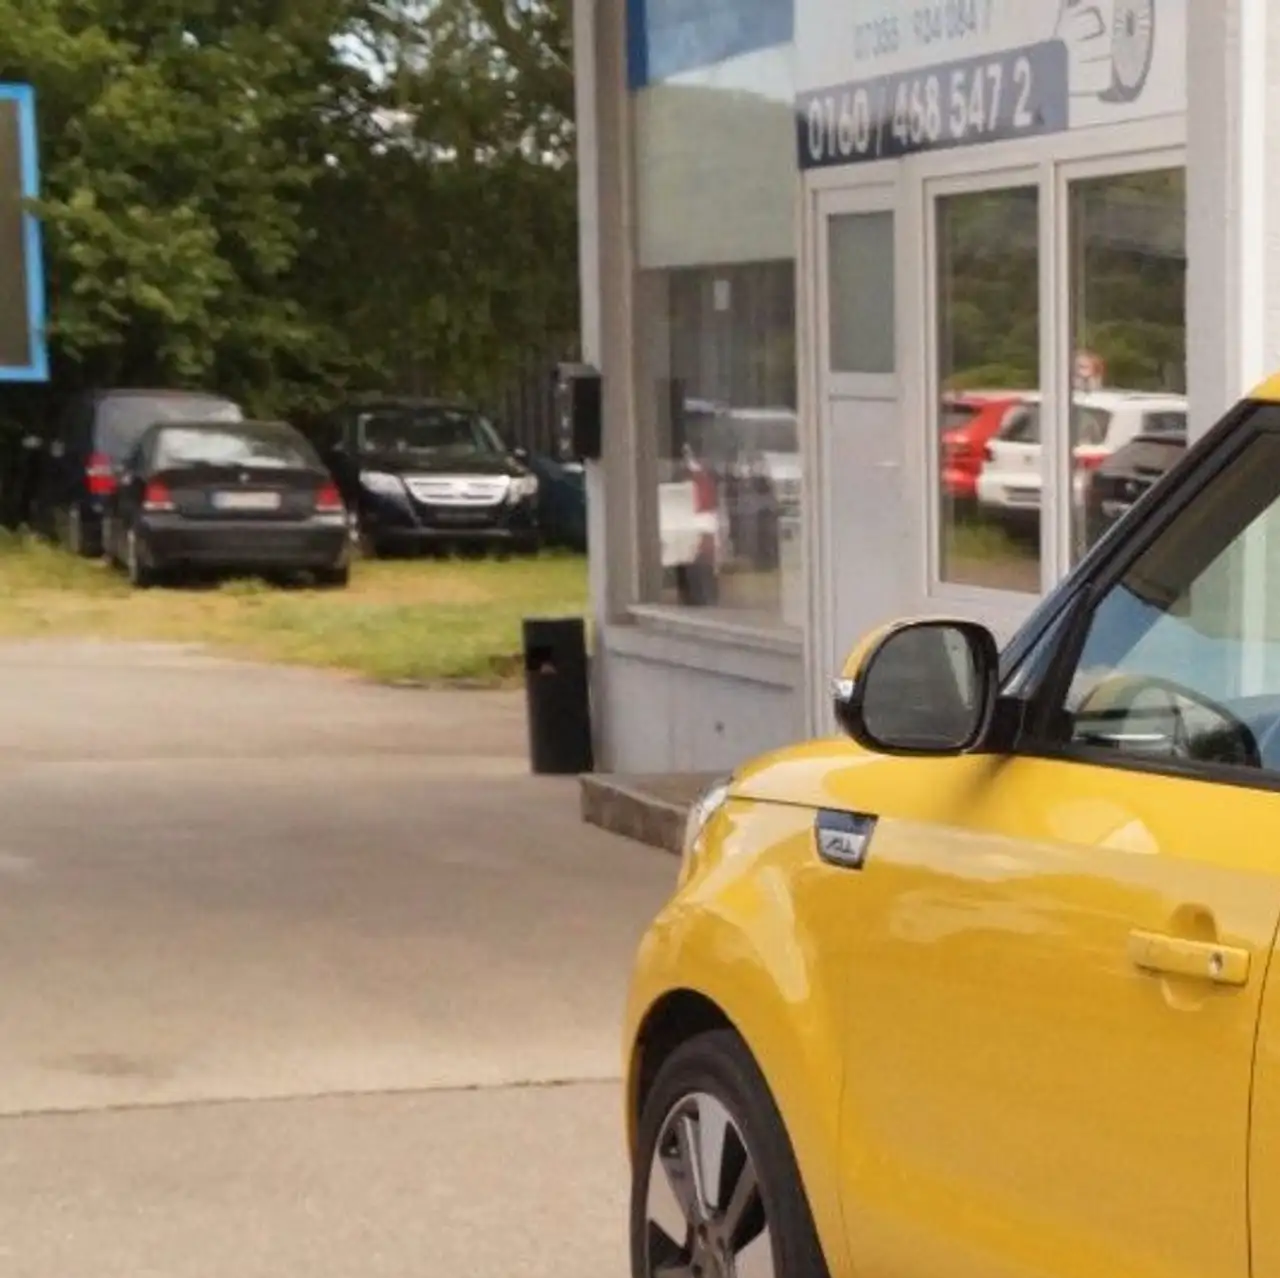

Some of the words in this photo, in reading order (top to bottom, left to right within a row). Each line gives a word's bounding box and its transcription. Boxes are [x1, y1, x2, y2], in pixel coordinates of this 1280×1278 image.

[808, 87, 869, 161] 0160
[892, 74, 941, 147] 468
[950, 62, 1003, 139] 547
[1012, 56, 1032, 128] 2
